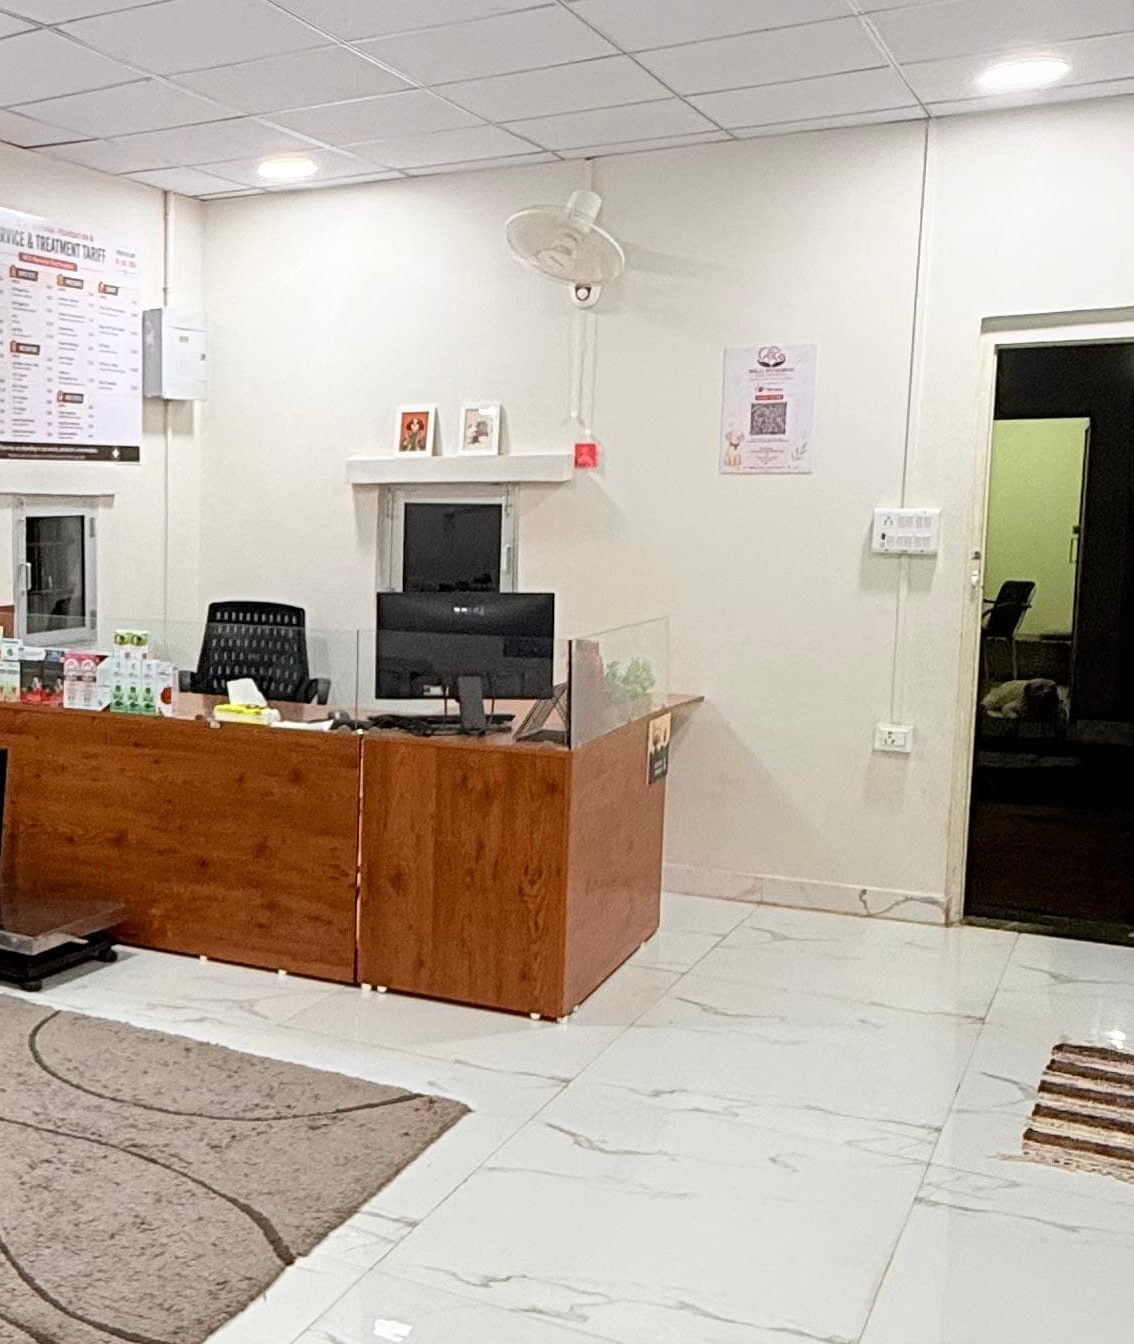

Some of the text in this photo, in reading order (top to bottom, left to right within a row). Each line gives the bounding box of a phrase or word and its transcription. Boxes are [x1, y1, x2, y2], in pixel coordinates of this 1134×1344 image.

[27, 233, 34, 249] &
[36, 234, 81, 258] TREATMENT
[82, 244, 107, 264] TARIFF
